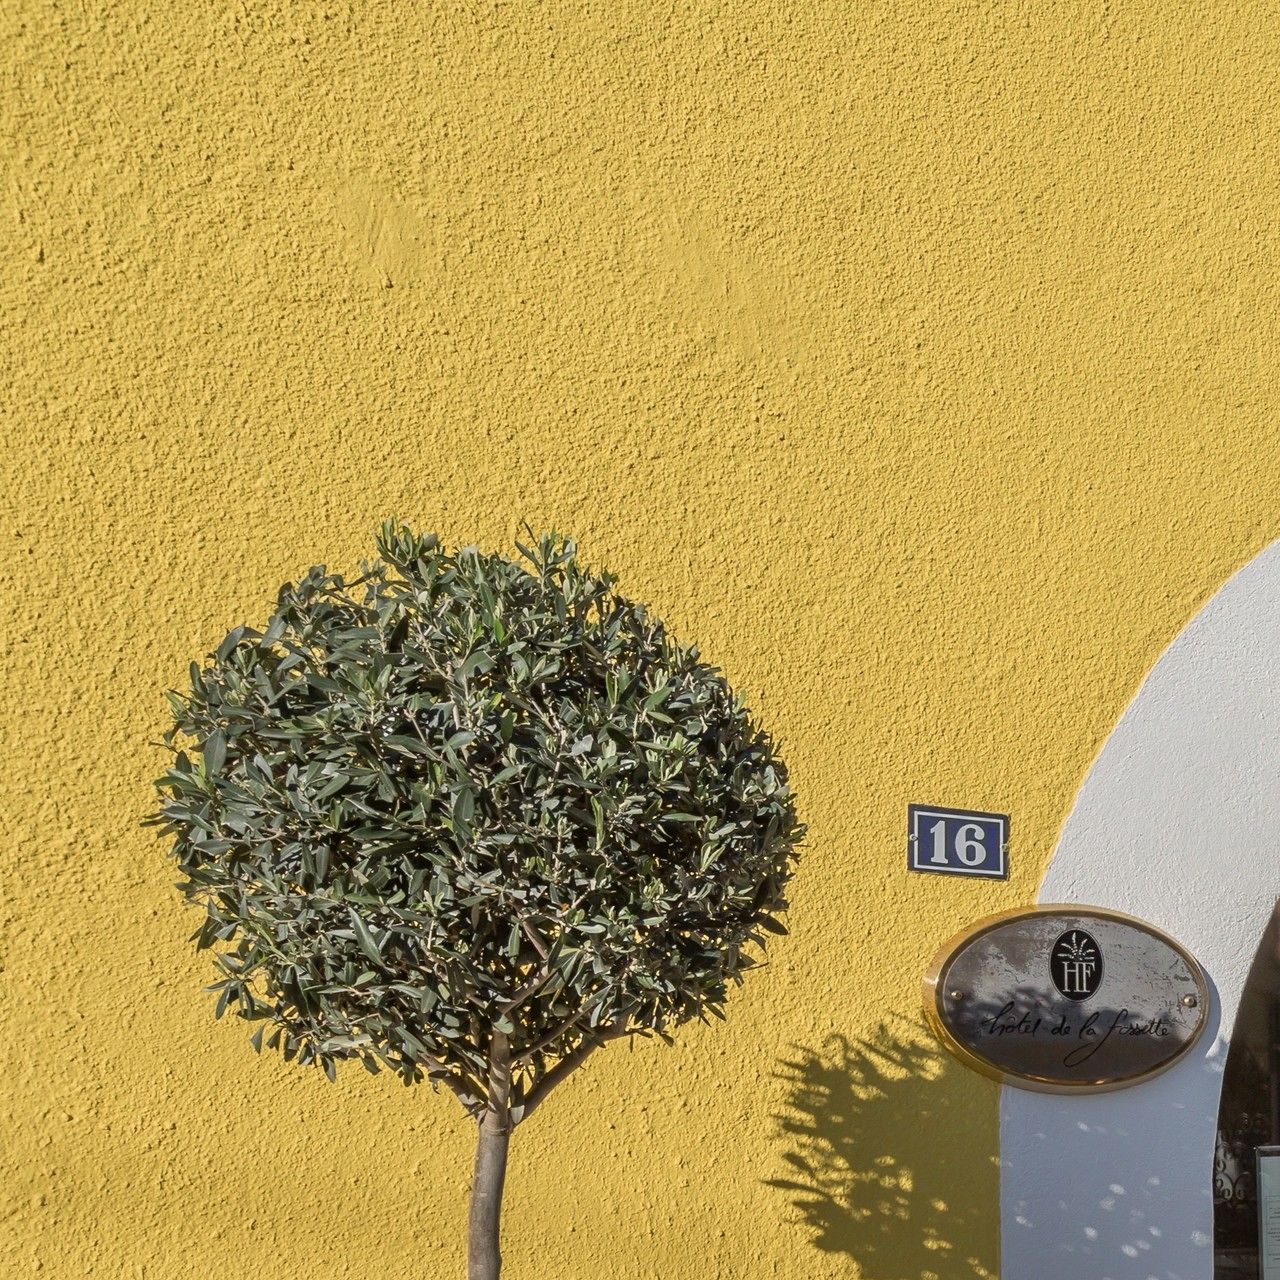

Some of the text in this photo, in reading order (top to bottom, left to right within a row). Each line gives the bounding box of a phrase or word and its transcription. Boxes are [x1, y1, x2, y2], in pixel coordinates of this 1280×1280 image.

[929, 820, 987, 866] 16
[1062, 961, 1096, 993] HF
[981, 1001, 1170, 1068] hôtel de la fossette
